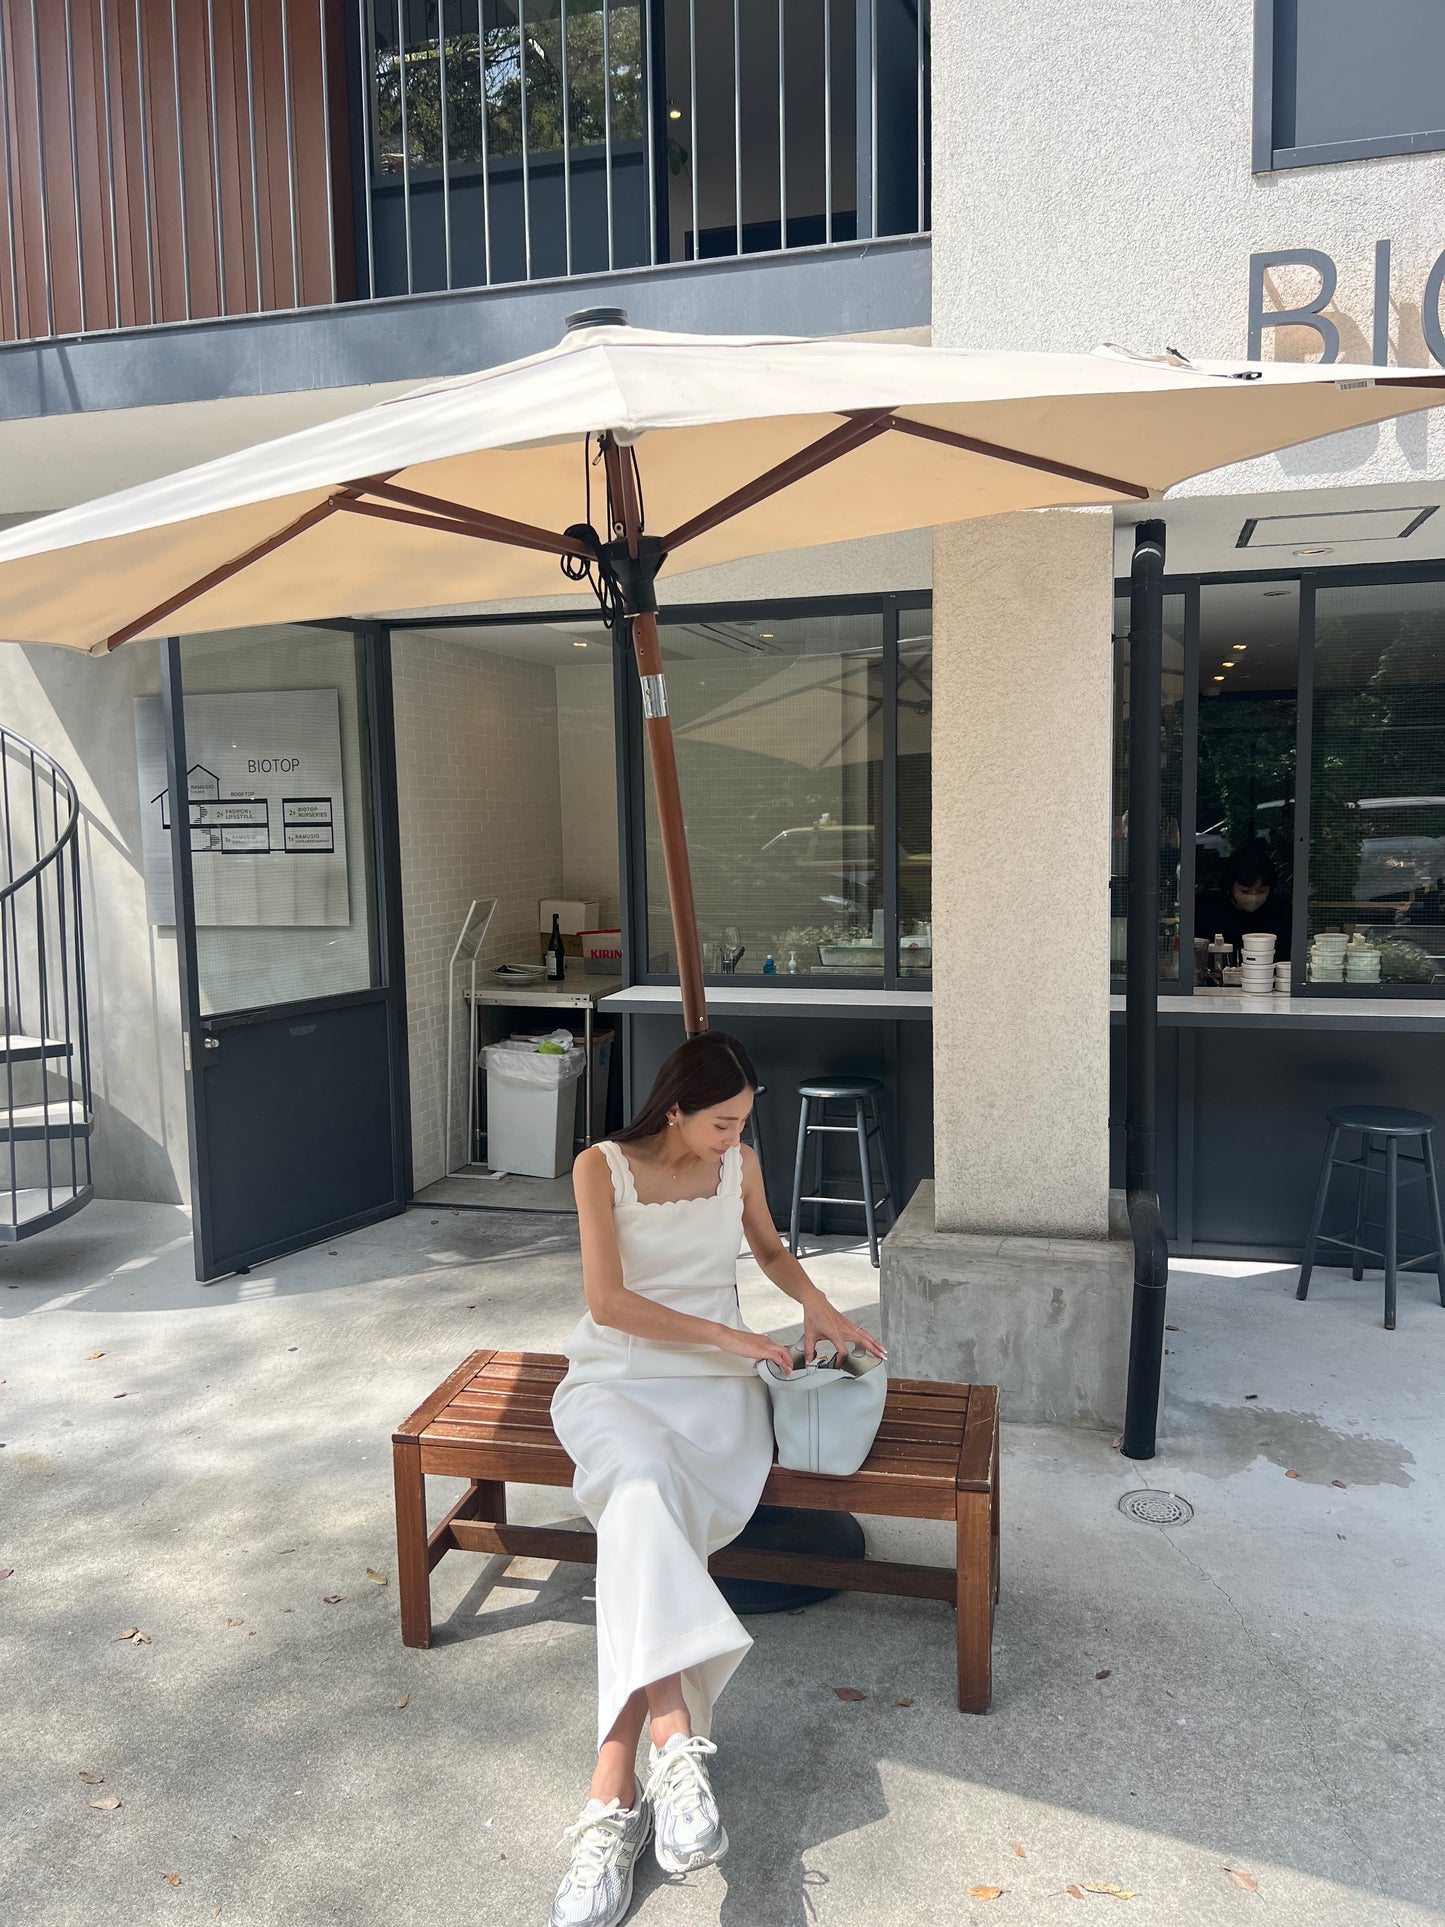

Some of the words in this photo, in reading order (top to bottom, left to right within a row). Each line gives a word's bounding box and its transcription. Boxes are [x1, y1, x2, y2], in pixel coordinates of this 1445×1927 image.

[1247, 239, 1445, 369] BI
[248, 758, 300, 774] BIOTOP
[590, 948, 622, 960] KIRIN
